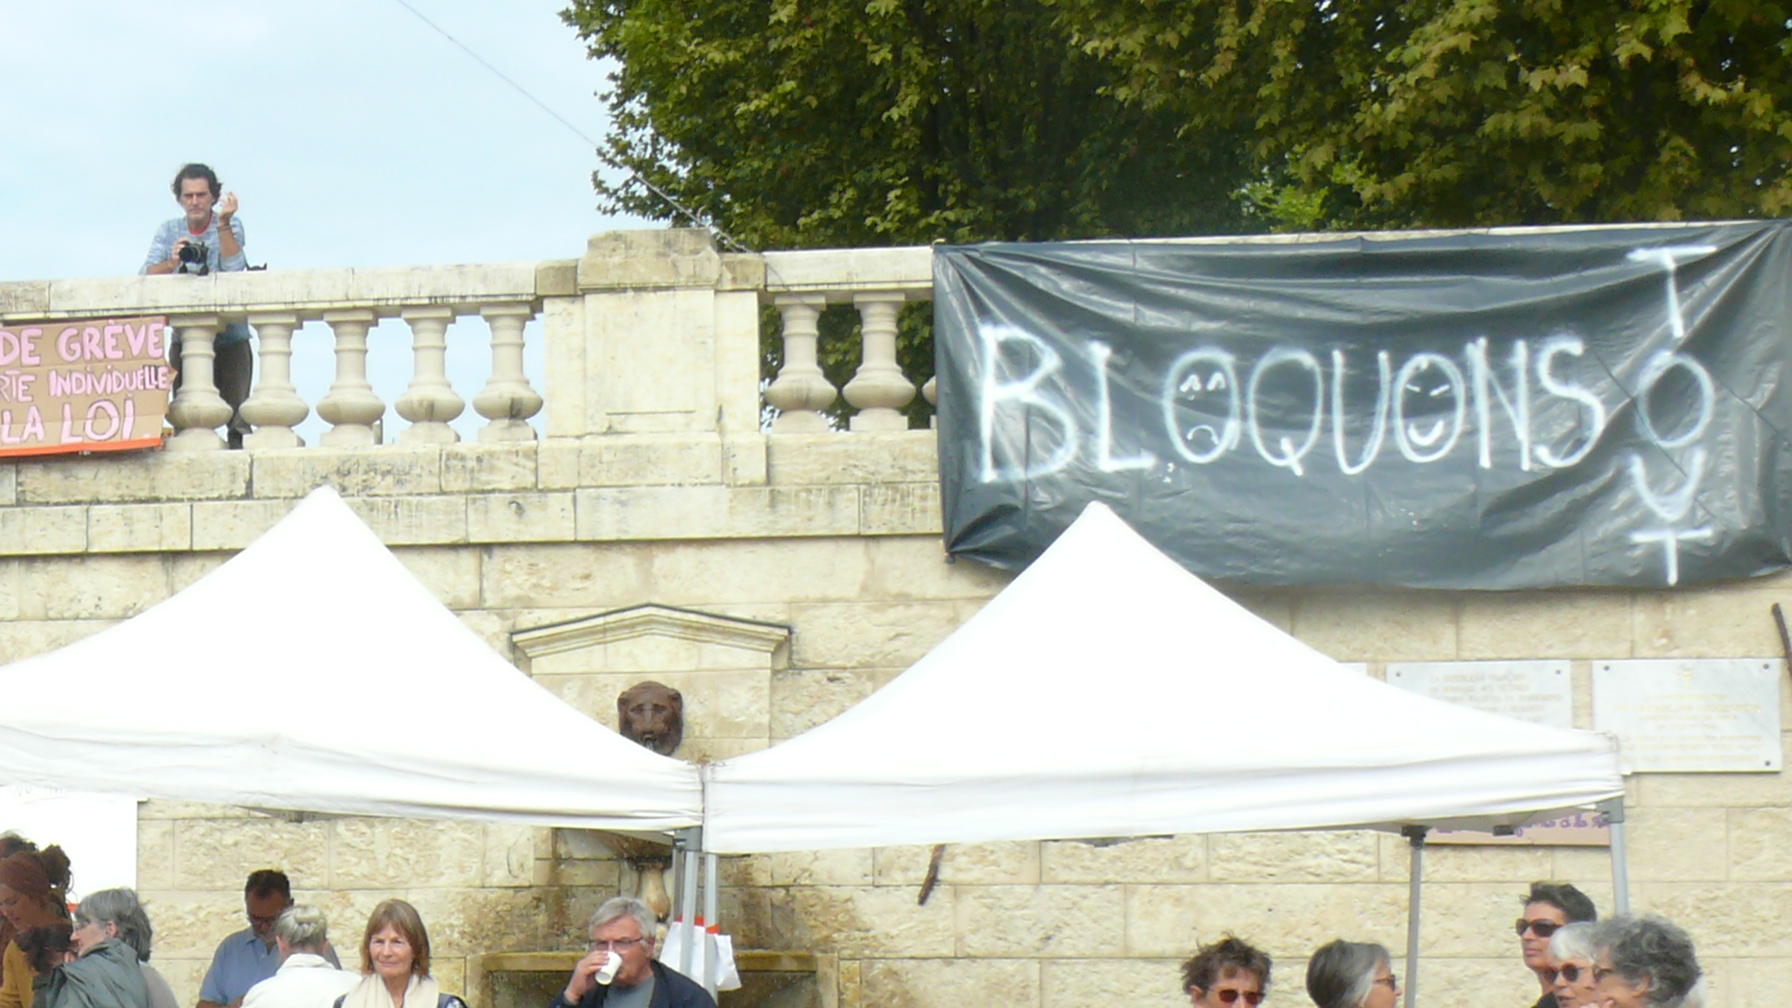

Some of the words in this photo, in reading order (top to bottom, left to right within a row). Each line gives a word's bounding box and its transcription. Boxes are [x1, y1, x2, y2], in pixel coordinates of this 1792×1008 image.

[57, 319, 165, 363] GRÈVE
[48, 364, 171, 398] INDIVIDUELLE
[977, 320, 1606, 484] BLOQUONS
[0, 405, 45, 446] LA
[1626, 244, 1719, 588] TOUT
